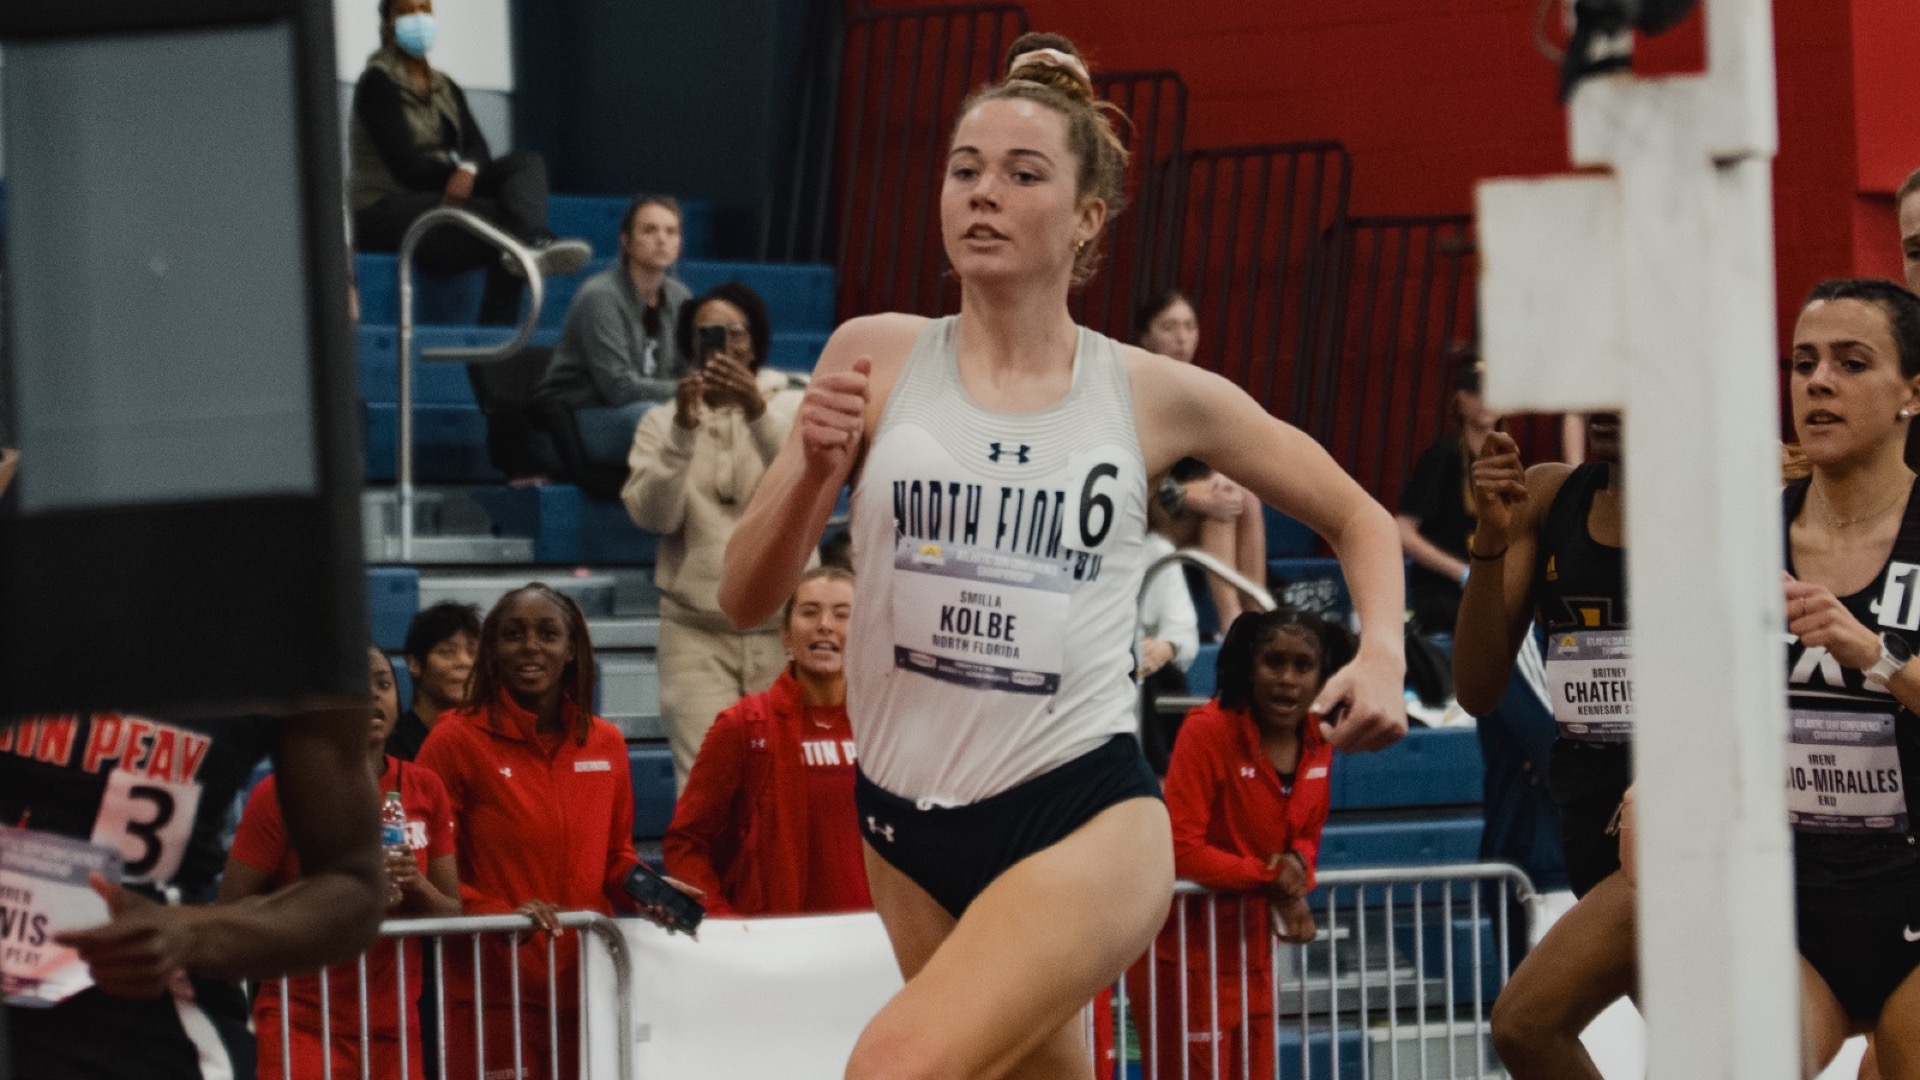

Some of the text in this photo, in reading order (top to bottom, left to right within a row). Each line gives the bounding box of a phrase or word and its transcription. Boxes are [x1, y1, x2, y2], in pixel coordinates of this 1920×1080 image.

[893, 479, 982, 551] NORTH
[1079, 463, 1119, 548] 6
[960, 590, 1002, 607] SMILLA
[1895, 568, 1919, 626] 1
[940, 605, 1017, 642] KOLBE
[932, 633, 1020, 660] NORTH FLORIDA
[1592, 667, 1627, 678] BRITNEY
[1577, 704, 1622, 716] KENNESAW
[82, 712, 212, 786] PEAY
[801, 740, 841, 766] TIN
[1808, 754, 1837, 767] IRENE
[1818, 795, 1837, 807] EKU
[124, 785, 175, 877] 3
